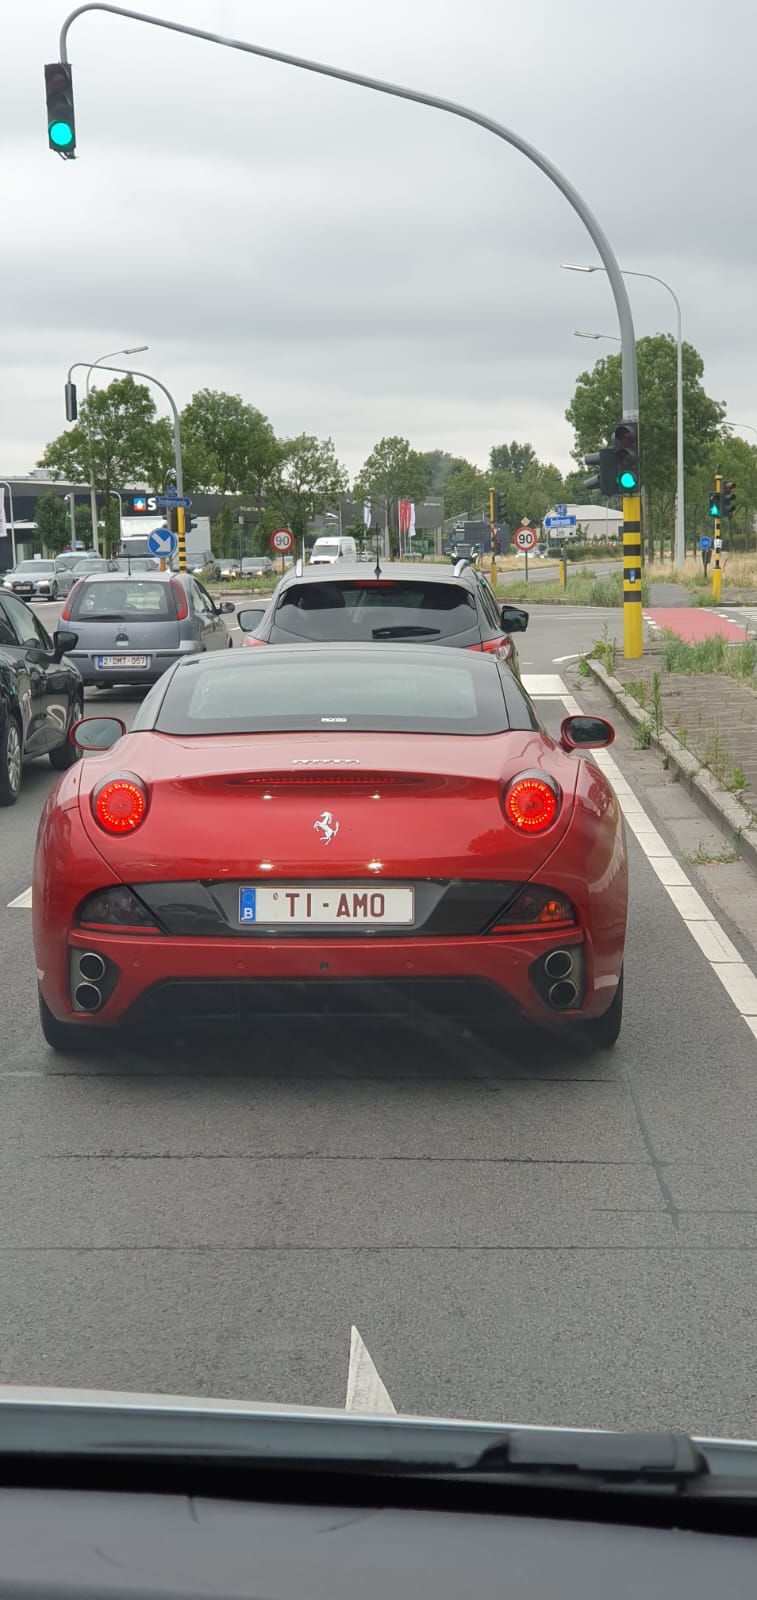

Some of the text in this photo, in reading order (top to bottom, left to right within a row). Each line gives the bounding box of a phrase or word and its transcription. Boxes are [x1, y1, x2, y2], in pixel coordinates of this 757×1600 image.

[275, 534, 290, 546] 90
[518, 533, 533, 545] 90
[243, 907, 253, 920] B
